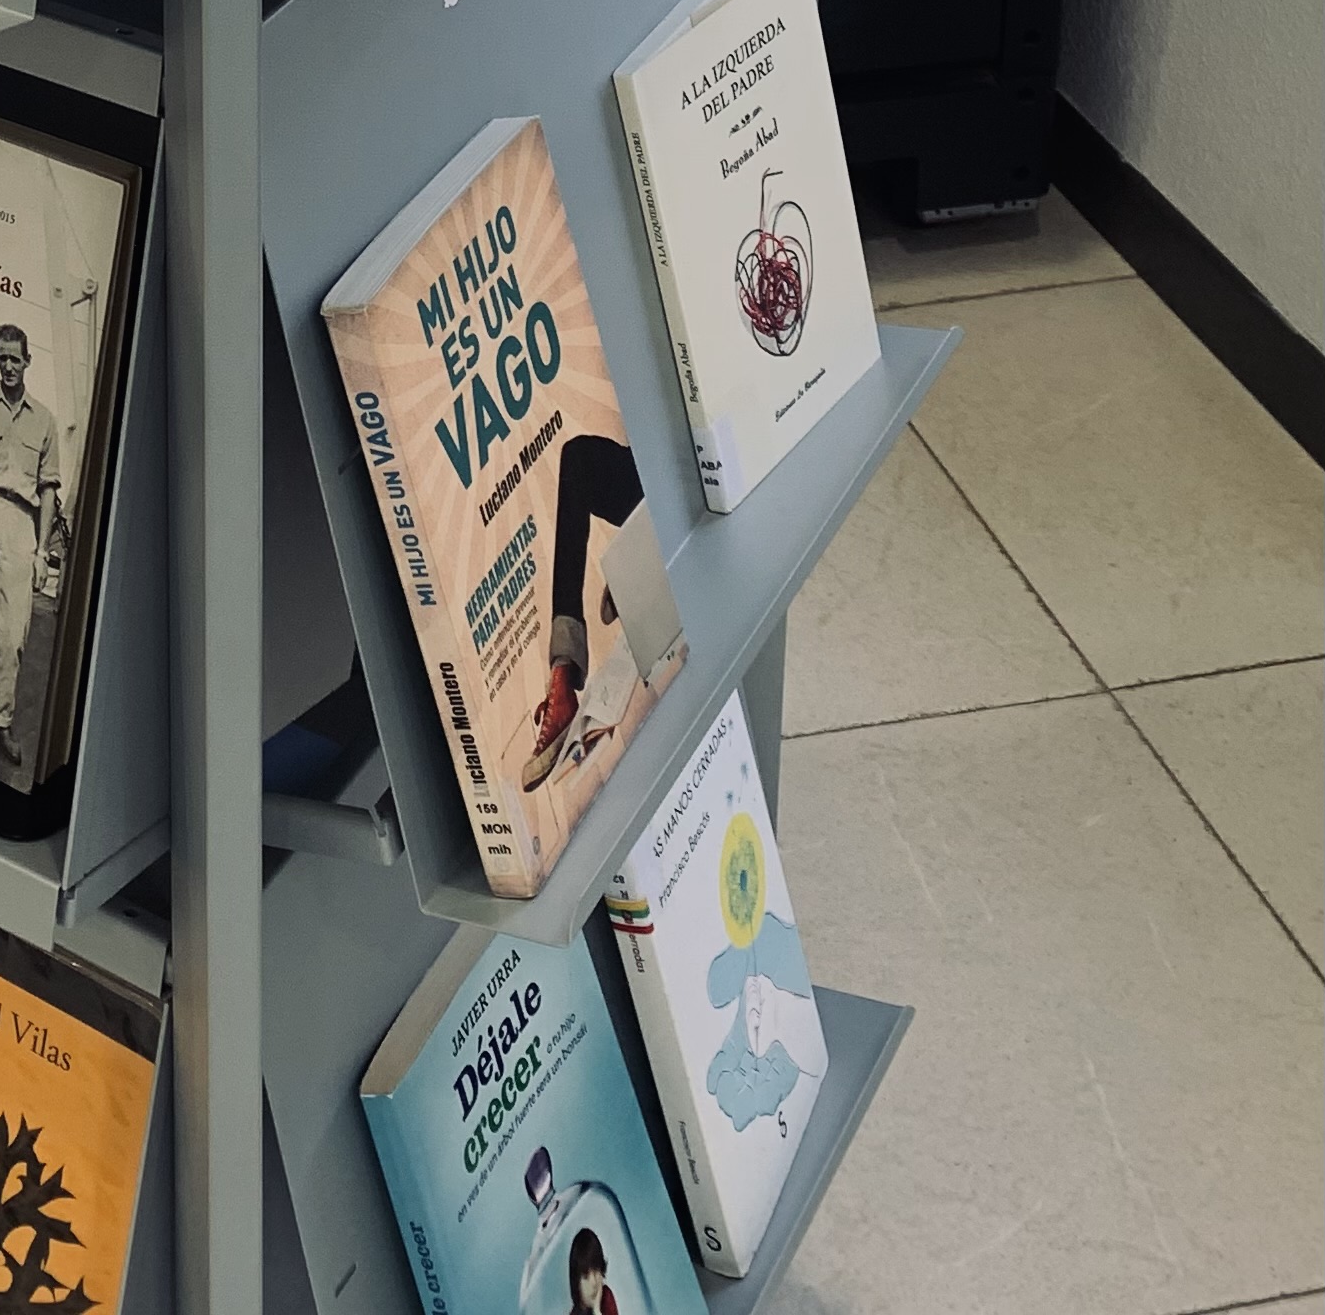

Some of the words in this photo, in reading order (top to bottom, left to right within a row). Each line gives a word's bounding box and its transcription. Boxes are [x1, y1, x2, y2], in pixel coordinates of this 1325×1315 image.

[680, 89, 692, 111] A
[692, 73, 712, 101] LA
[711, 17, 787, 91] IZQUIERDA
[702, 92, 731, 125] DEL
[730, 54, 775, 110] PADRE
[721, 143, 755, 180] Begoña
[755, 119, 780, 153] Abad
[417, 273, 455, 348] MI
[453, 205, 517, 305] HIJO
[441, 315, 480, 391] ES
[479, 264, 524, 339] UN
[435, 301, 561, 490] VAGO
[479, 470, 522, 527] Luciano
[519, 409, 563, 475] Montero
[465, 514, 537, 629] HERRAMIENTAS
[472, 604, 500, 655] PARA
[497, 551, 537, 618] PADRES
[476, 803, 498, 814] 159
[482, 822, 512, 835] MON
[488, 842, 512, 855] mih
[10, 1011, 72, 1072] Vilas
[452, 993, 489, 1057] JAVIER
[486, 949, 521, 999] URRA
[453, 981, 542, 1123] Déjale
[463, 1035, 541, 1174] crecer
